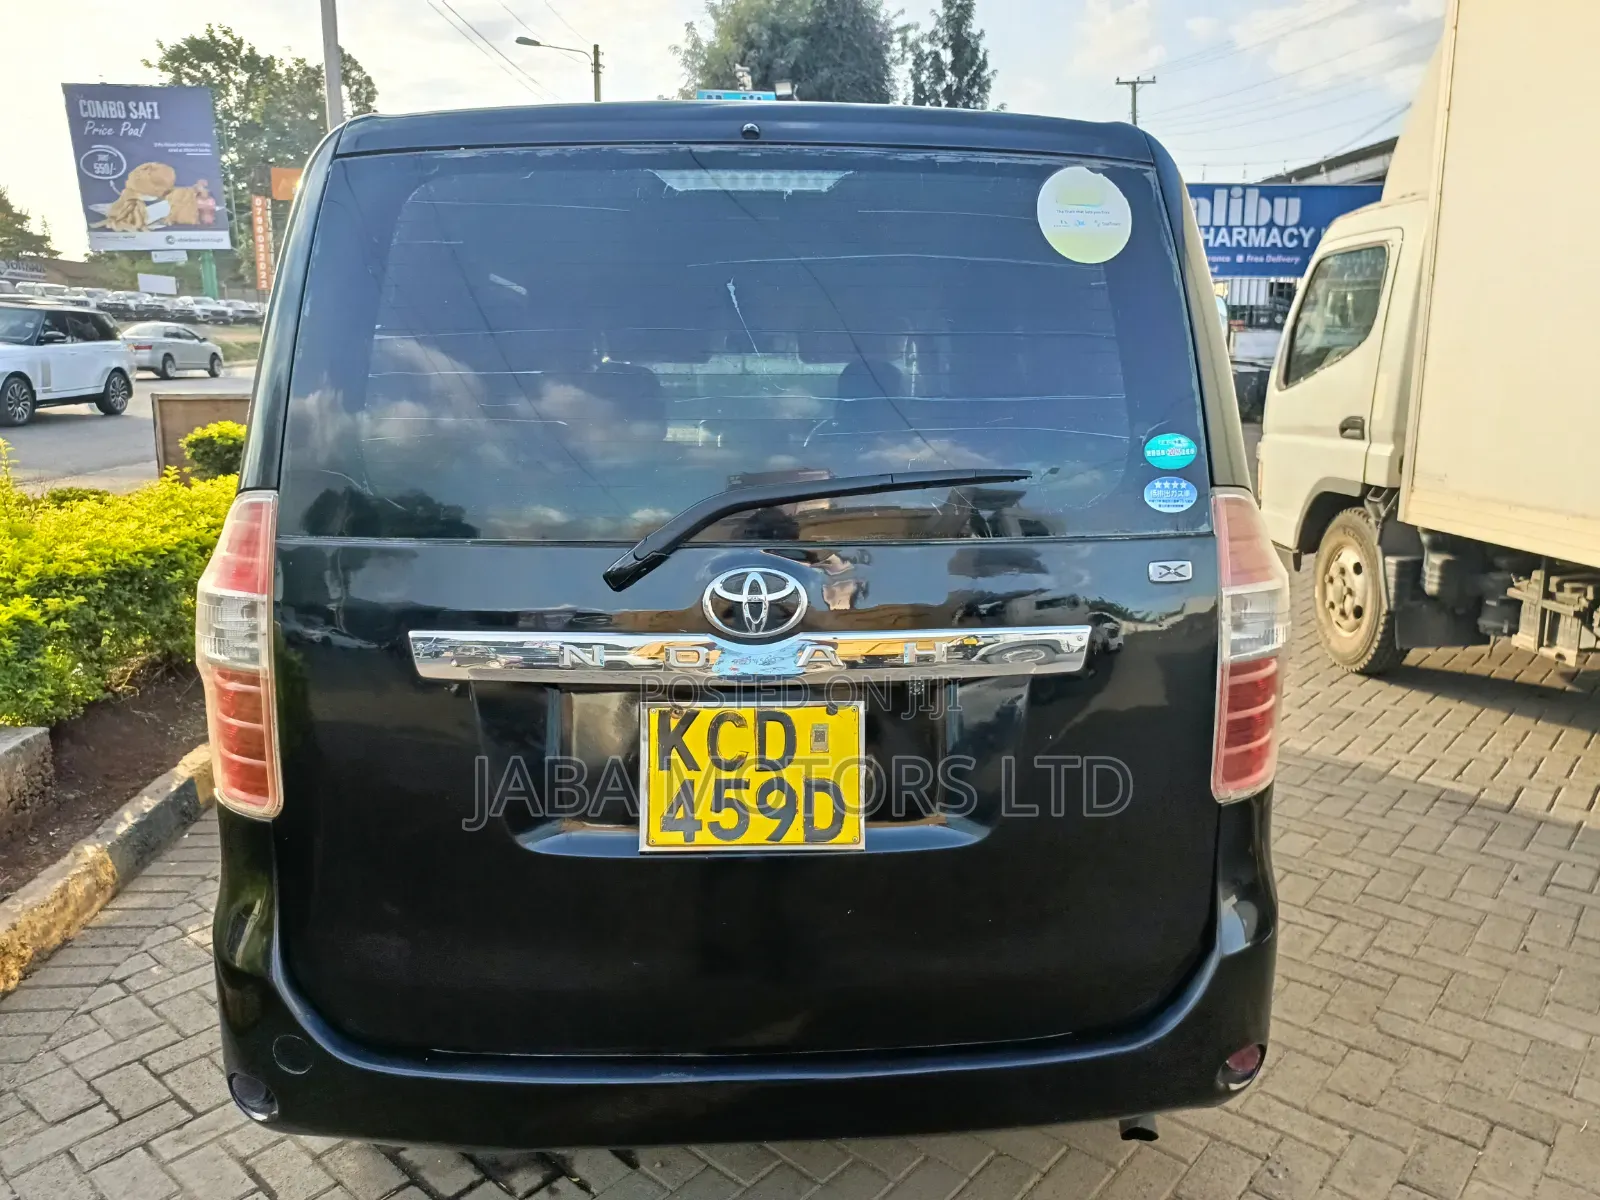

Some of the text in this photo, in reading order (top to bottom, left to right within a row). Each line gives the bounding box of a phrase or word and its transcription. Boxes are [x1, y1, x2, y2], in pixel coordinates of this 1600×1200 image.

[79, 99, 160, 120] COMBO SAFI
[84, 120, 147, 138] Price Poa!
[1192, 186, 1302, 227] alibu
[1200, 227, 1316, 249] HARMACY
[1246, 254, 1264, 264] Free
[1265, 254, 1301, 265] Delivery
[657, 708, 797, 772] KCD
[660, 777, 845, 843] 459D
